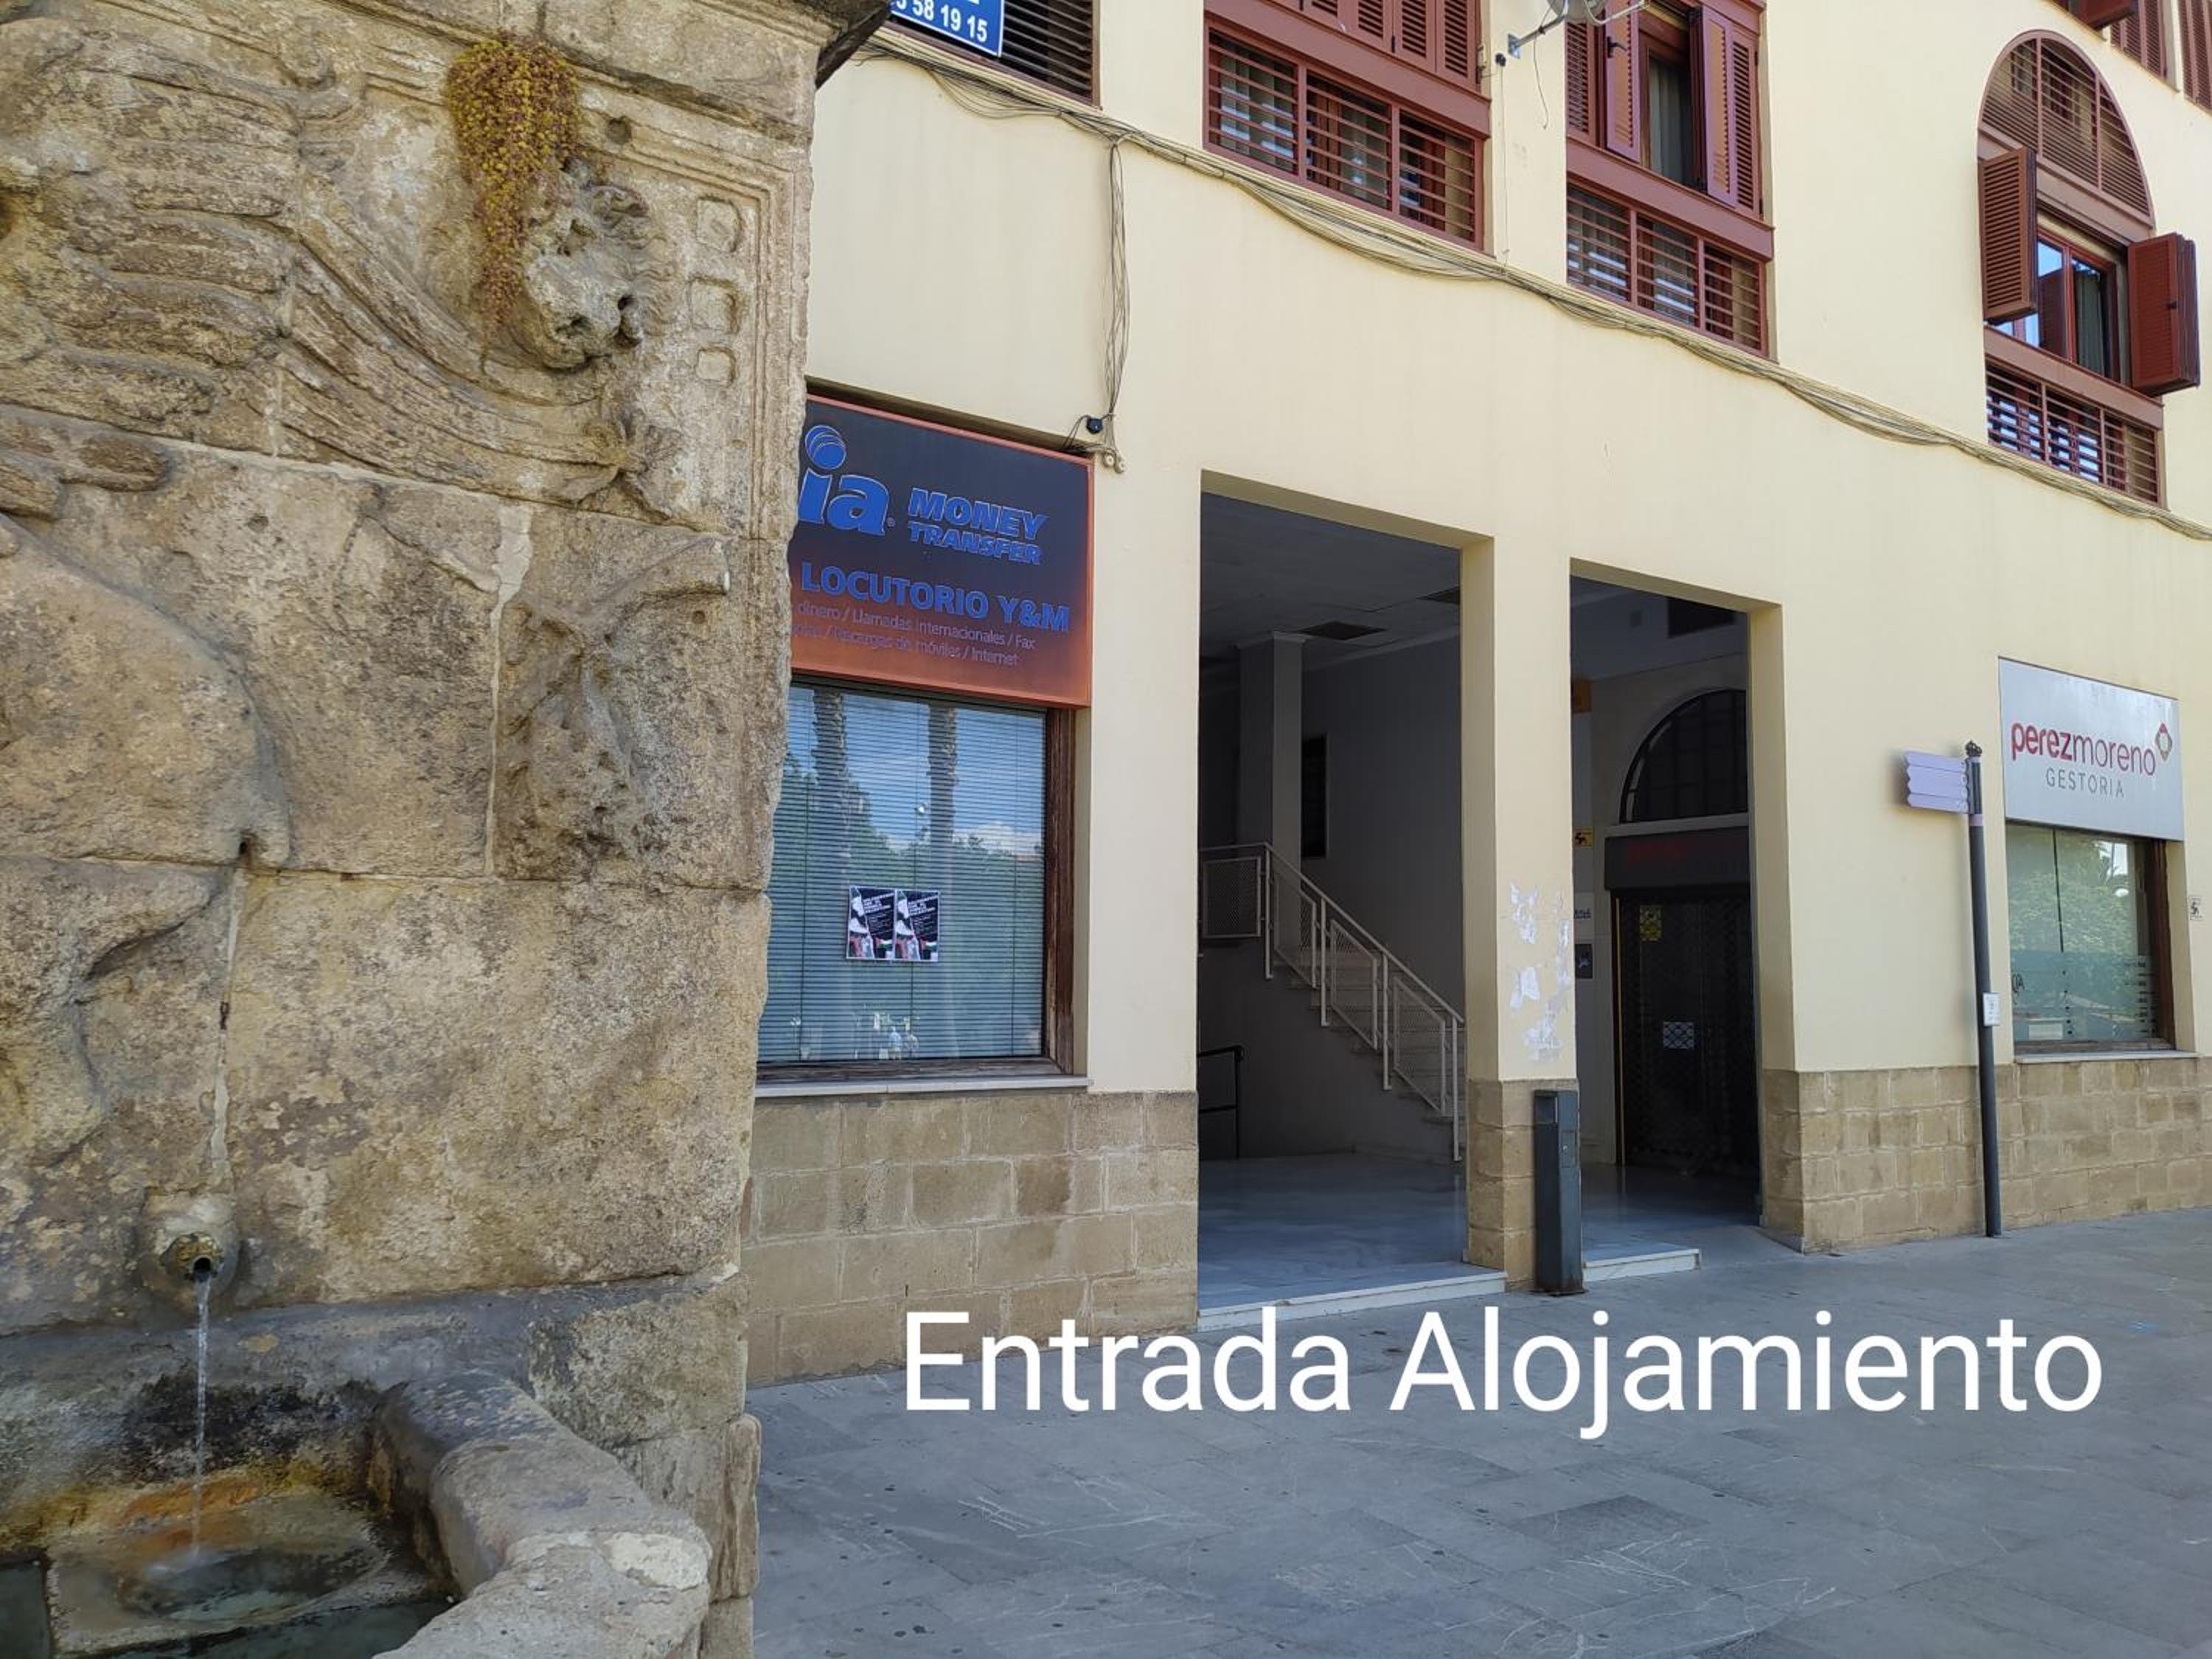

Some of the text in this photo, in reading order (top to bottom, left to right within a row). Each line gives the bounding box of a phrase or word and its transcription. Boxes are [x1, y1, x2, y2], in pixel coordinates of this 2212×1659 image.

[912, 0, 987, 42] 58 19 15
[908, 487, 1049, 540] MONEY
[908, 521, 1040, 566] TRANSFER
[802, 561, 1070, 631] LOCUTORIO Y&M
[798, 600, 839, 620] dinero
[852, 608, 911, 630] Llamadas
[1015, 633, 1037, 650] Fax
[897, 635, 909, 650] de
[971, 647, 1018, 666] Internet
[2011, 722, 2156, 776] perezmoreno
[2045, 767, 2125, 798] GESTORIA
